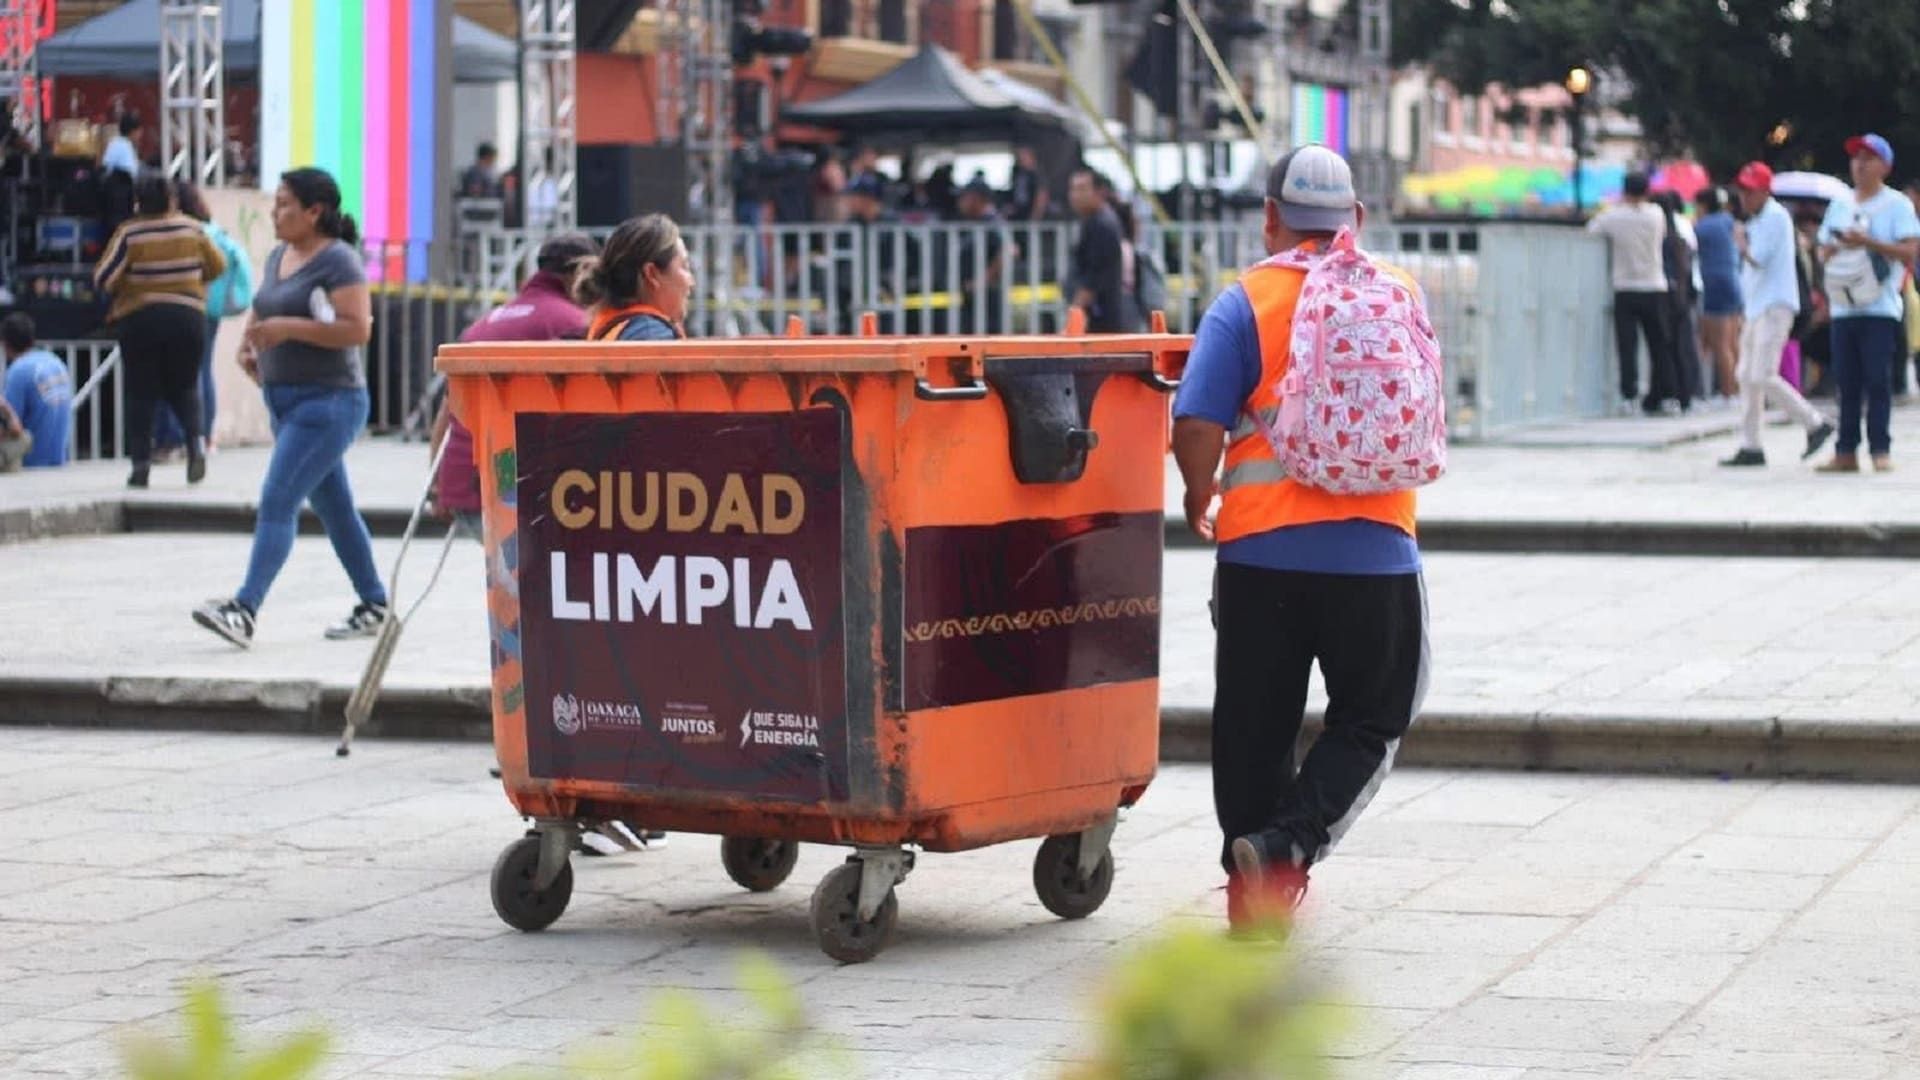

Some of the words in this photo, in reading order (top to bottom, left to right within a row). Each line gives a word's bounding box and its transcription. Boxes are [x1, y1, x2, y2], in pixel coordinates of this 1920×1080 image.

[551, 469, 805, 534] CIUDAD
[550, 551, 813, 631] LIMPIA
[587, 702, 641, 718] OAXACA
[661, 717, 716, 735] JUNTOS
[753, 712, 775, 727] QUE
[777, 713, 802, 728] SIGA
[804, 715, 819, 730] LA
[754, 729, 819, 747] ENERGÍA
